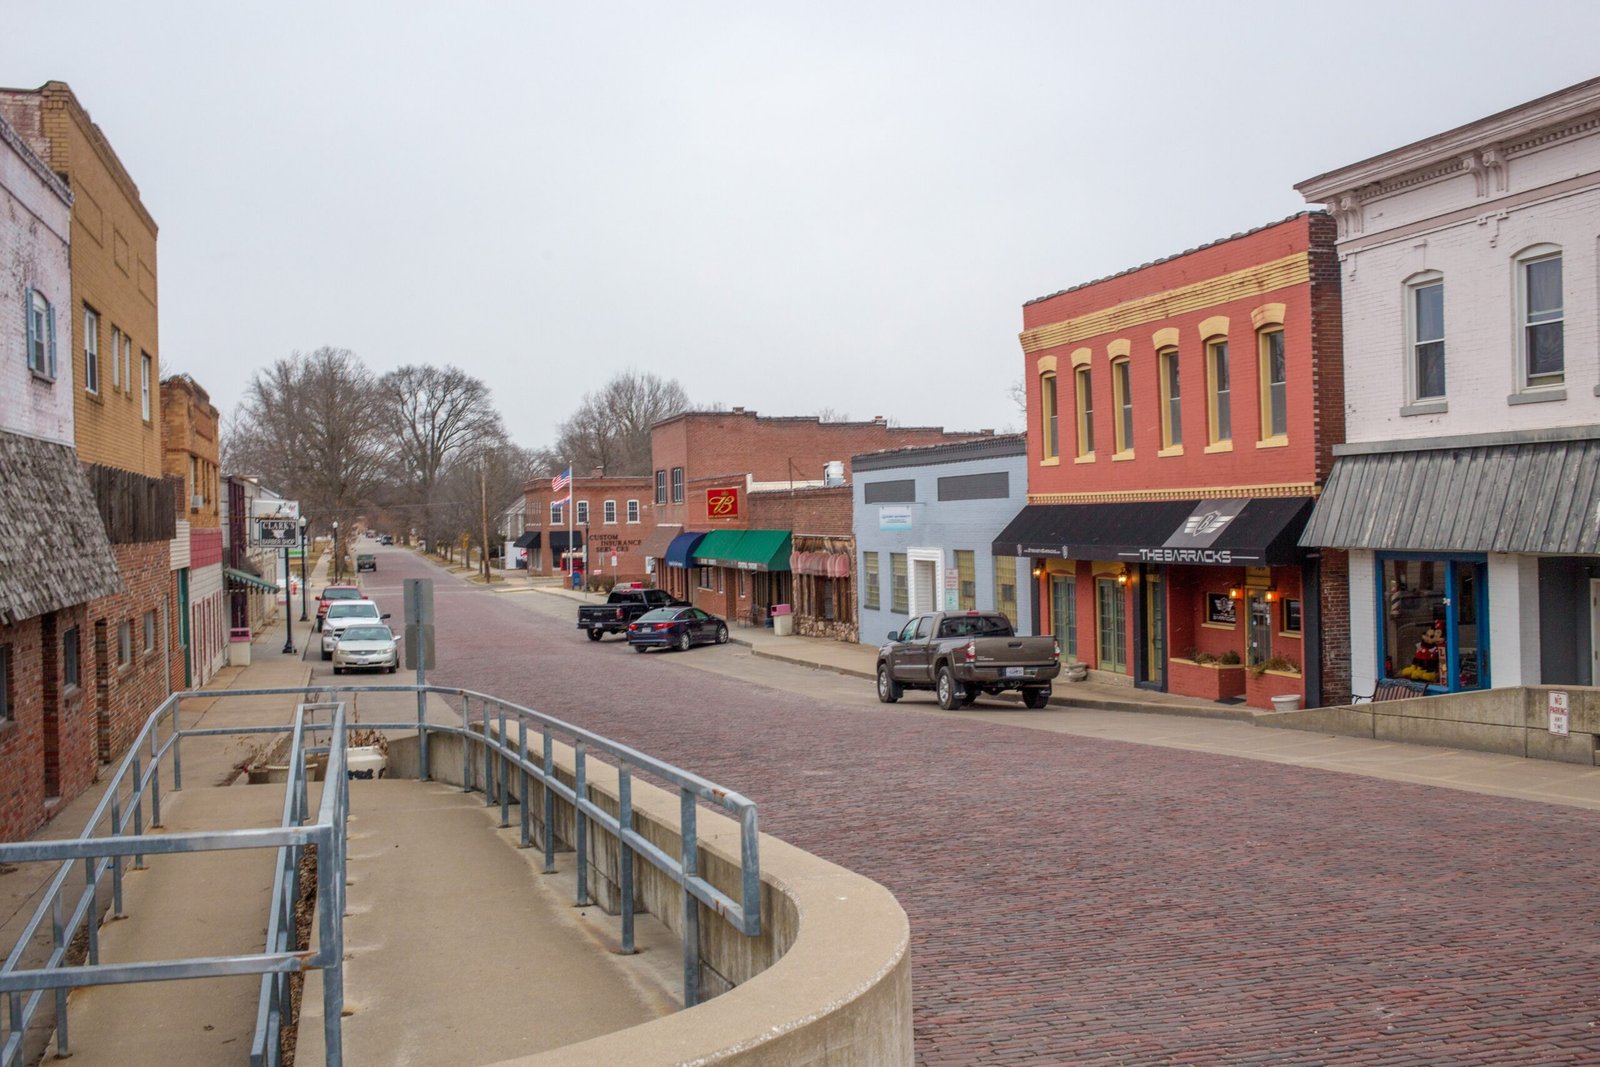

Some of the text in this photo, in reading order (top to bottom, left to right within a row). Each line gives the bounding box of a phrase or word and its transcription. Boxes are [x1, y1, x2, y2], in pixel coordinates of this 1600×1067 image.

[262, 522, 295, 530] CLARK'S
[600, 539, 642, 547] INSURANCE
[595, 545, 629, 553] SERVCES
[1139, 548, 1232, 563] THE BARRACKS
[1554, 696, 1563, 706] NO
[1550, 705, 1568, 716] PARKING
